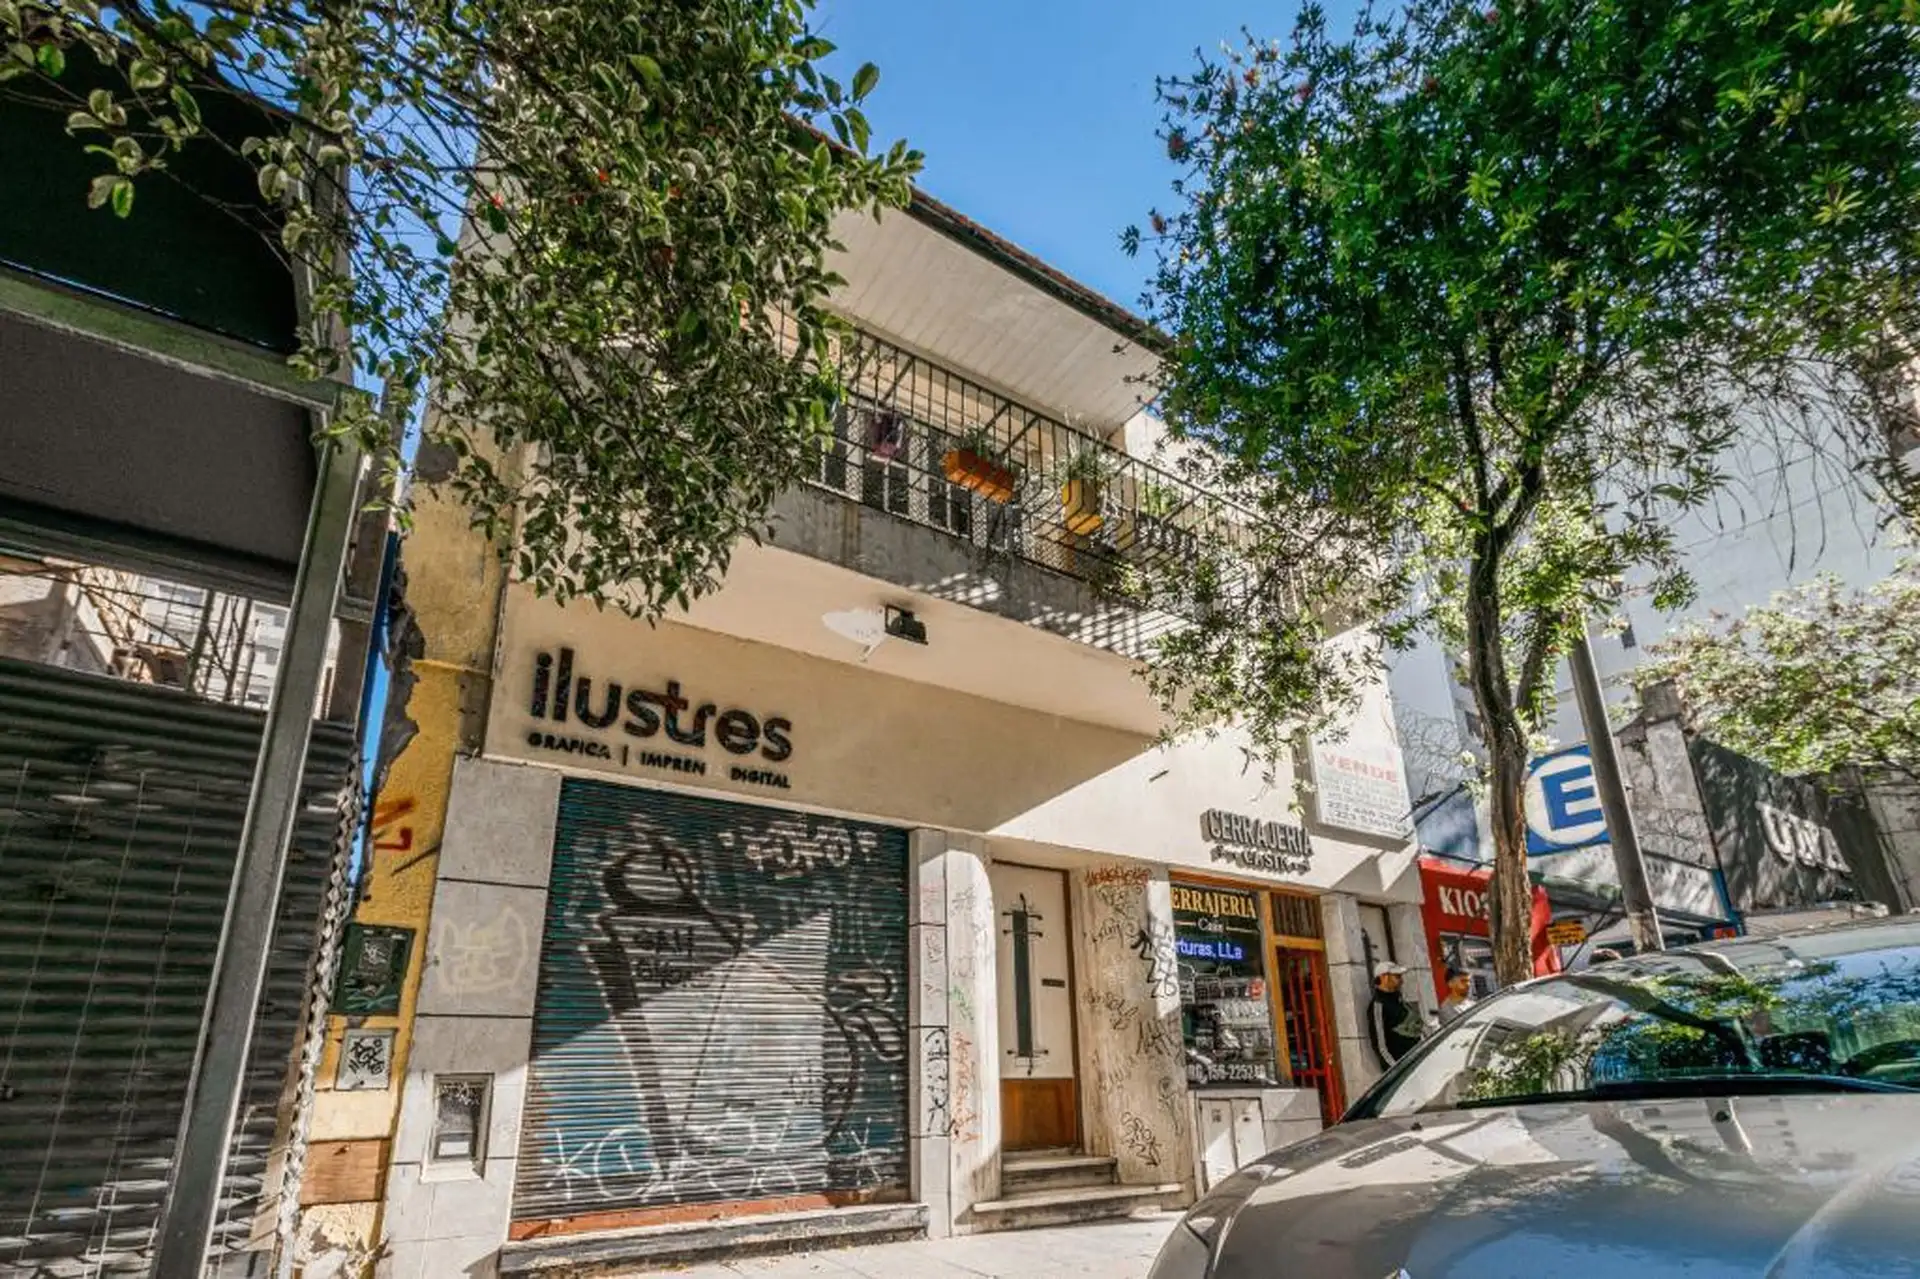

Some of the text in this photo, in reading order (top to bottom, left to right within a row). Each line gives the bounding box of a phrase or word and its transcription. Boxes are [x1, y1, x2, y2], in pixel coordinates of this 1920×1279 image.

[530, 647, 793, 763] ilustres
[527, 732, 611, 760] GRAFICA
[730, 767, 792, 789] DIGITAL
[1322, 751, 1397, 784] VENDE
[1540, 764, 1604, 831] E
[1201, 808, 1314, 857] CERRAJERIA
[1170, 886, 1257, 919] ERRAJERIA
